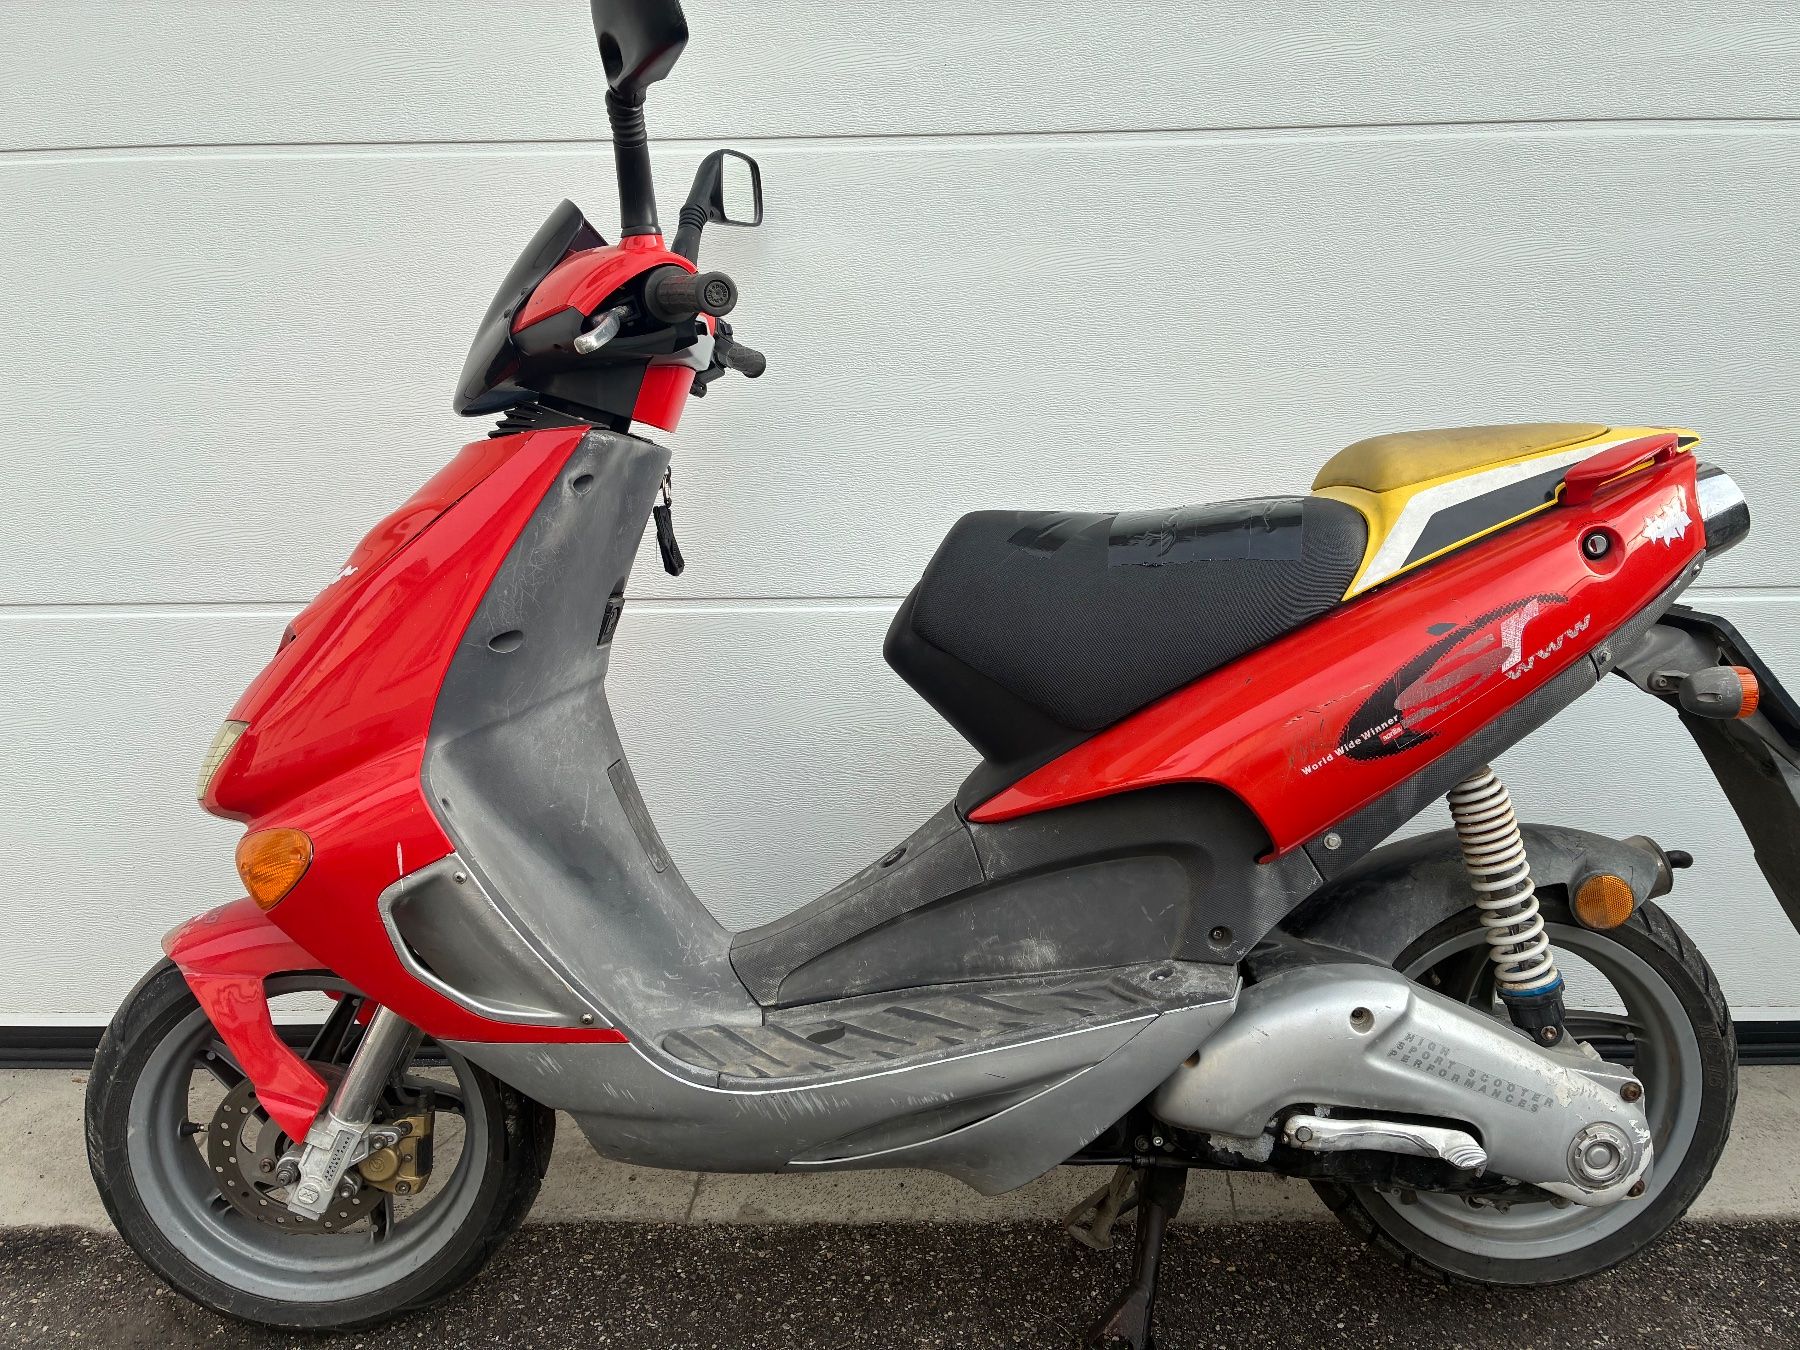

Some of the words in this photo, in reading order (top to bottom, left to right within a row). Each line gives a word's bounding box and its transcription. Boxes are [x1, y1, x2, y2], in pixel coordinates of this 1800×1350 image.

[1301, 753, 1334, 776] World
[1333, 738, 1362, 757] Wide
[1360, 714, 1399, 741] Winner
[1382, 725, 1402, 742] aprilia
[1396, 1041, 1456, 1070] SPORT
[1467, 1067, 1554, 1107] SCOOTER
[1404, 1032, 1450, 1057] HIGH
[1387, 1050, 1539, 1113] PERFORMANCES
